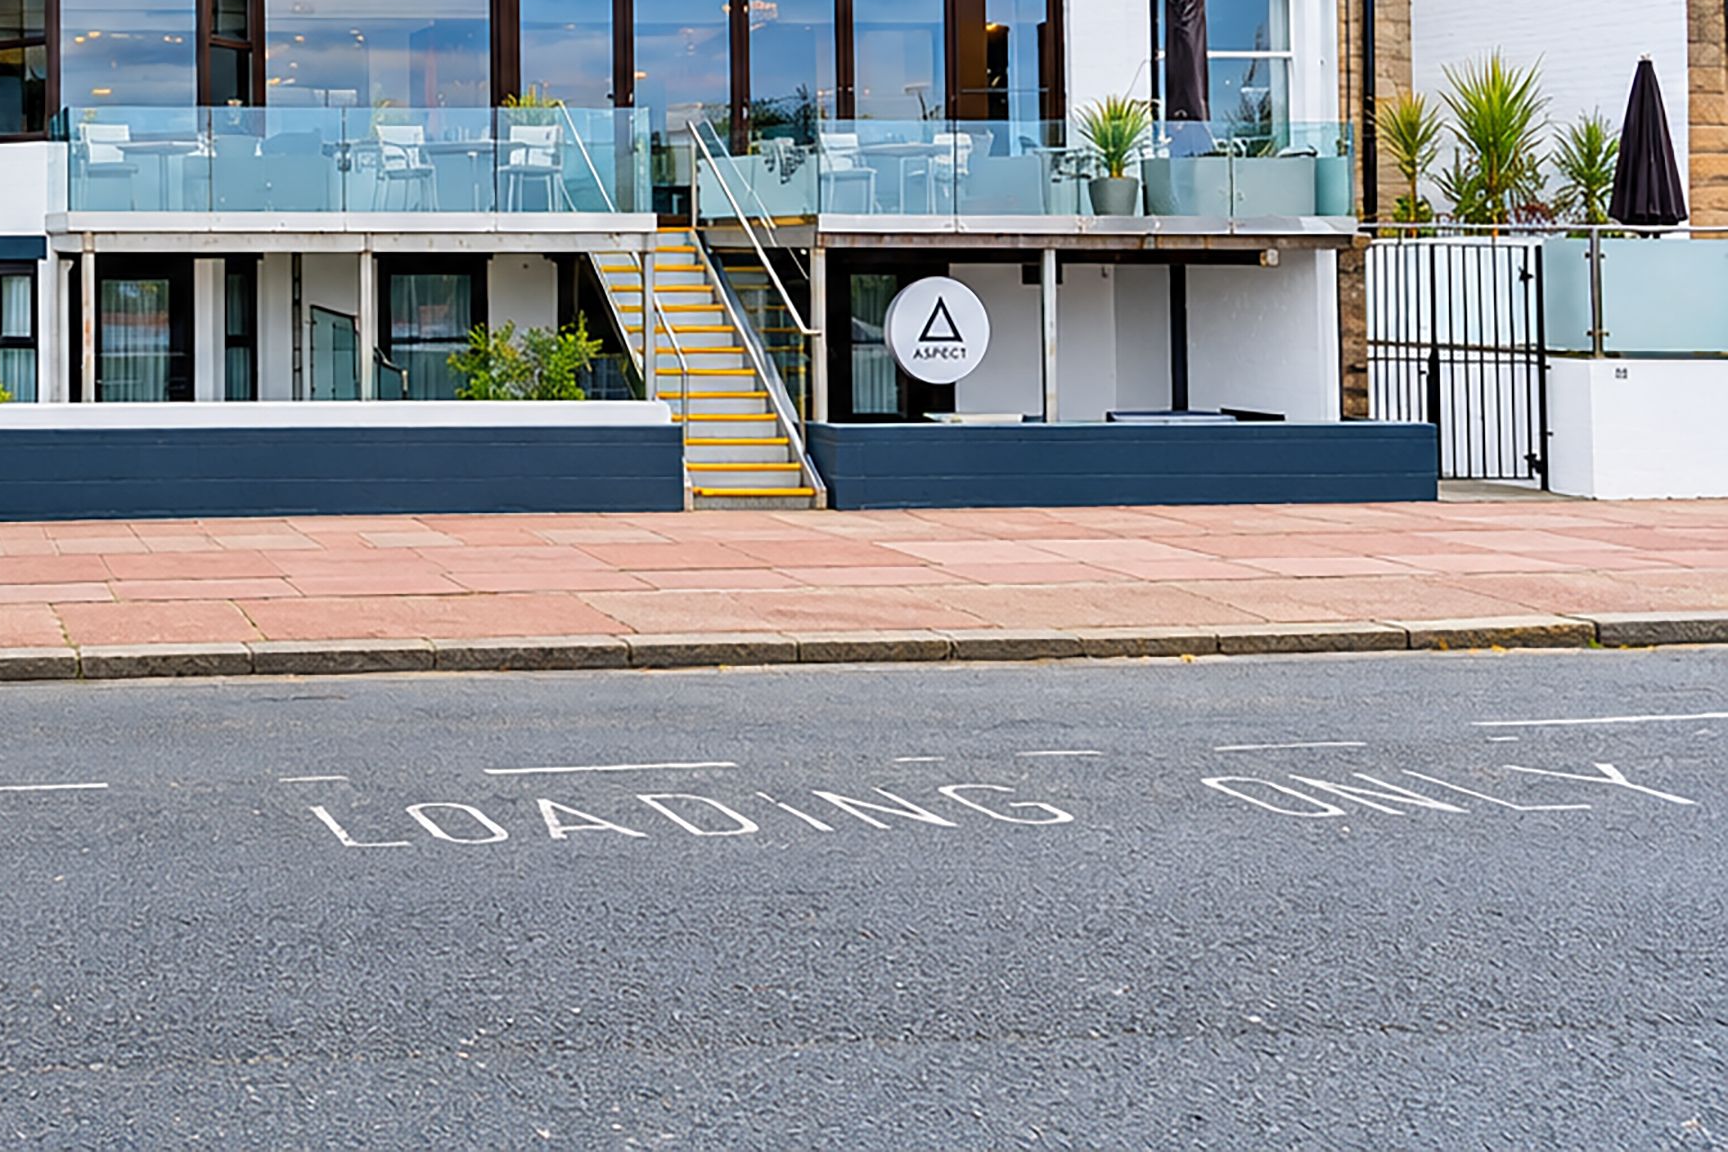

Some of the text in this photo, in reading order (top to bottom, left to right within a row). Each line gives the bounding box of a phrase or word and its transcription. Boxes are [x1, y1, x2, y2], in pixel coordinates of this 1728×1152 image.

[913, 348, 966, 359] ASPECT
[310, 762, 1696, 848] LOADING ONLY
